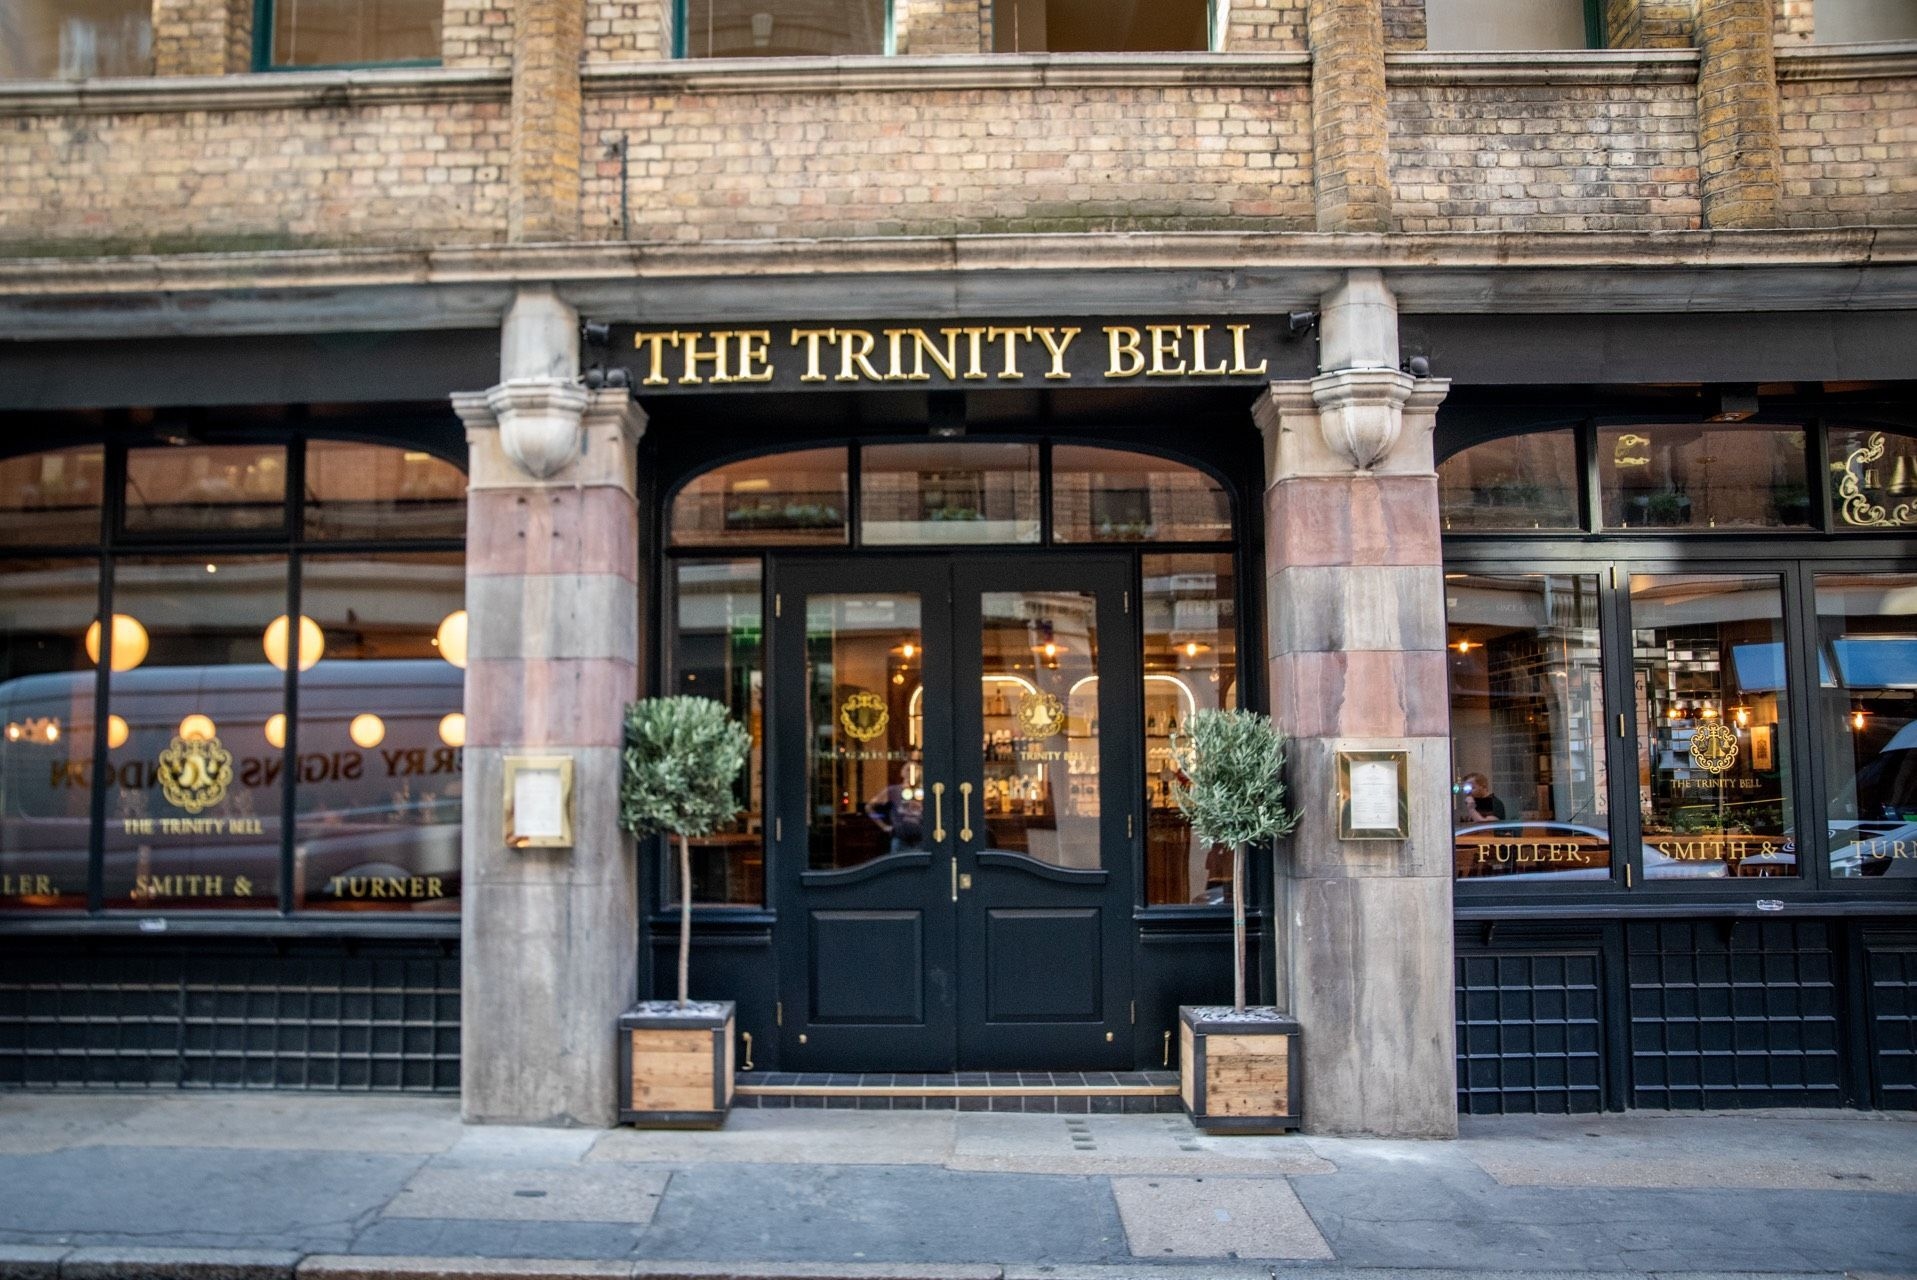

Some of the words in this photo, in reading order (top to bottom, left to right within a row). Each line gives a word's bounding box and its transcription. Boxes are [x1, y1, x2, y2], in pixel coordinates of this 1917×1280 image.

[634, 329, 774, 385] THE
[790, 325, 1081, 382] TRINITY
[1102, 323, 1267, 377] BELL
[1670, 778, 1692, 789] THE
[1696, 778, 1737, 789] TRINITY
[1739, 778, 1762, 789] BELL
[123, 817, 154, 836] THE
[158, 817, 224, 836] TRINITY
[1477, 843, 1592, 864] FULLER,
[1658, 840, 1747, 861] SMITH
[1760, 841, 1778, 861] &
[135, 874, 223, 897] SMITH
[233, 874, 253, 897] &
[331, 876, 443, 898] TURNER
